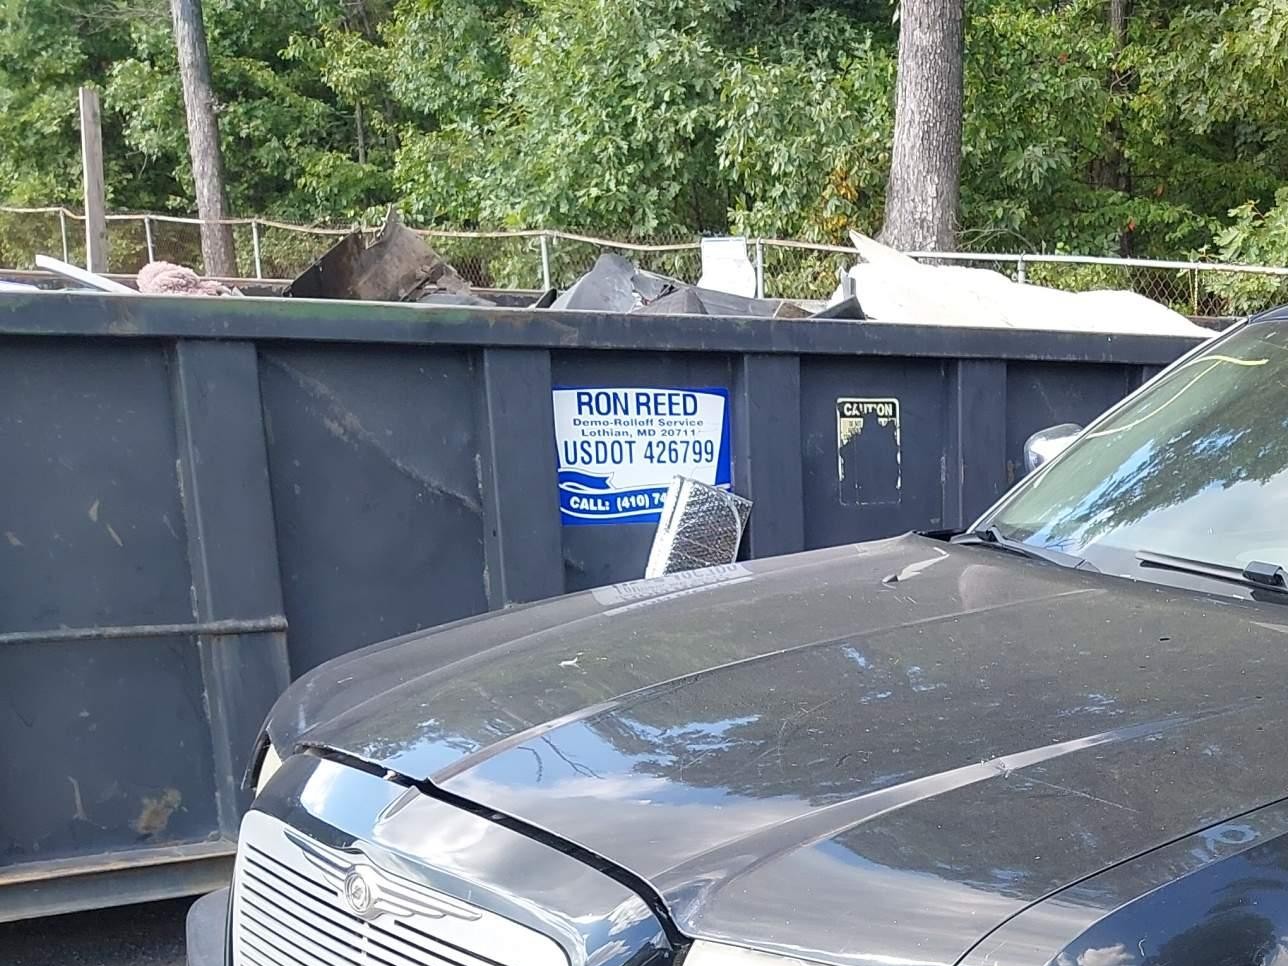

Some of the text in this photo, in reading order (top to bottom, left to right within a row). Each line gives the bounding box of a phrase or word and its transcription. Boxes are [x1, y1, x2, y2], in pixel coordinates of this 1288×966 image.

[576, 391, 699, 416] RON REED
[573, 418, 704, 427] Demo-Rolloff Service
[581, 428, 697, 438] Lothian, MD 20711
[564, 439, 715, 465] USDOT 426799
[569, 496, 610, 511] CALL:
[616, 493, 650, 512] (410)
